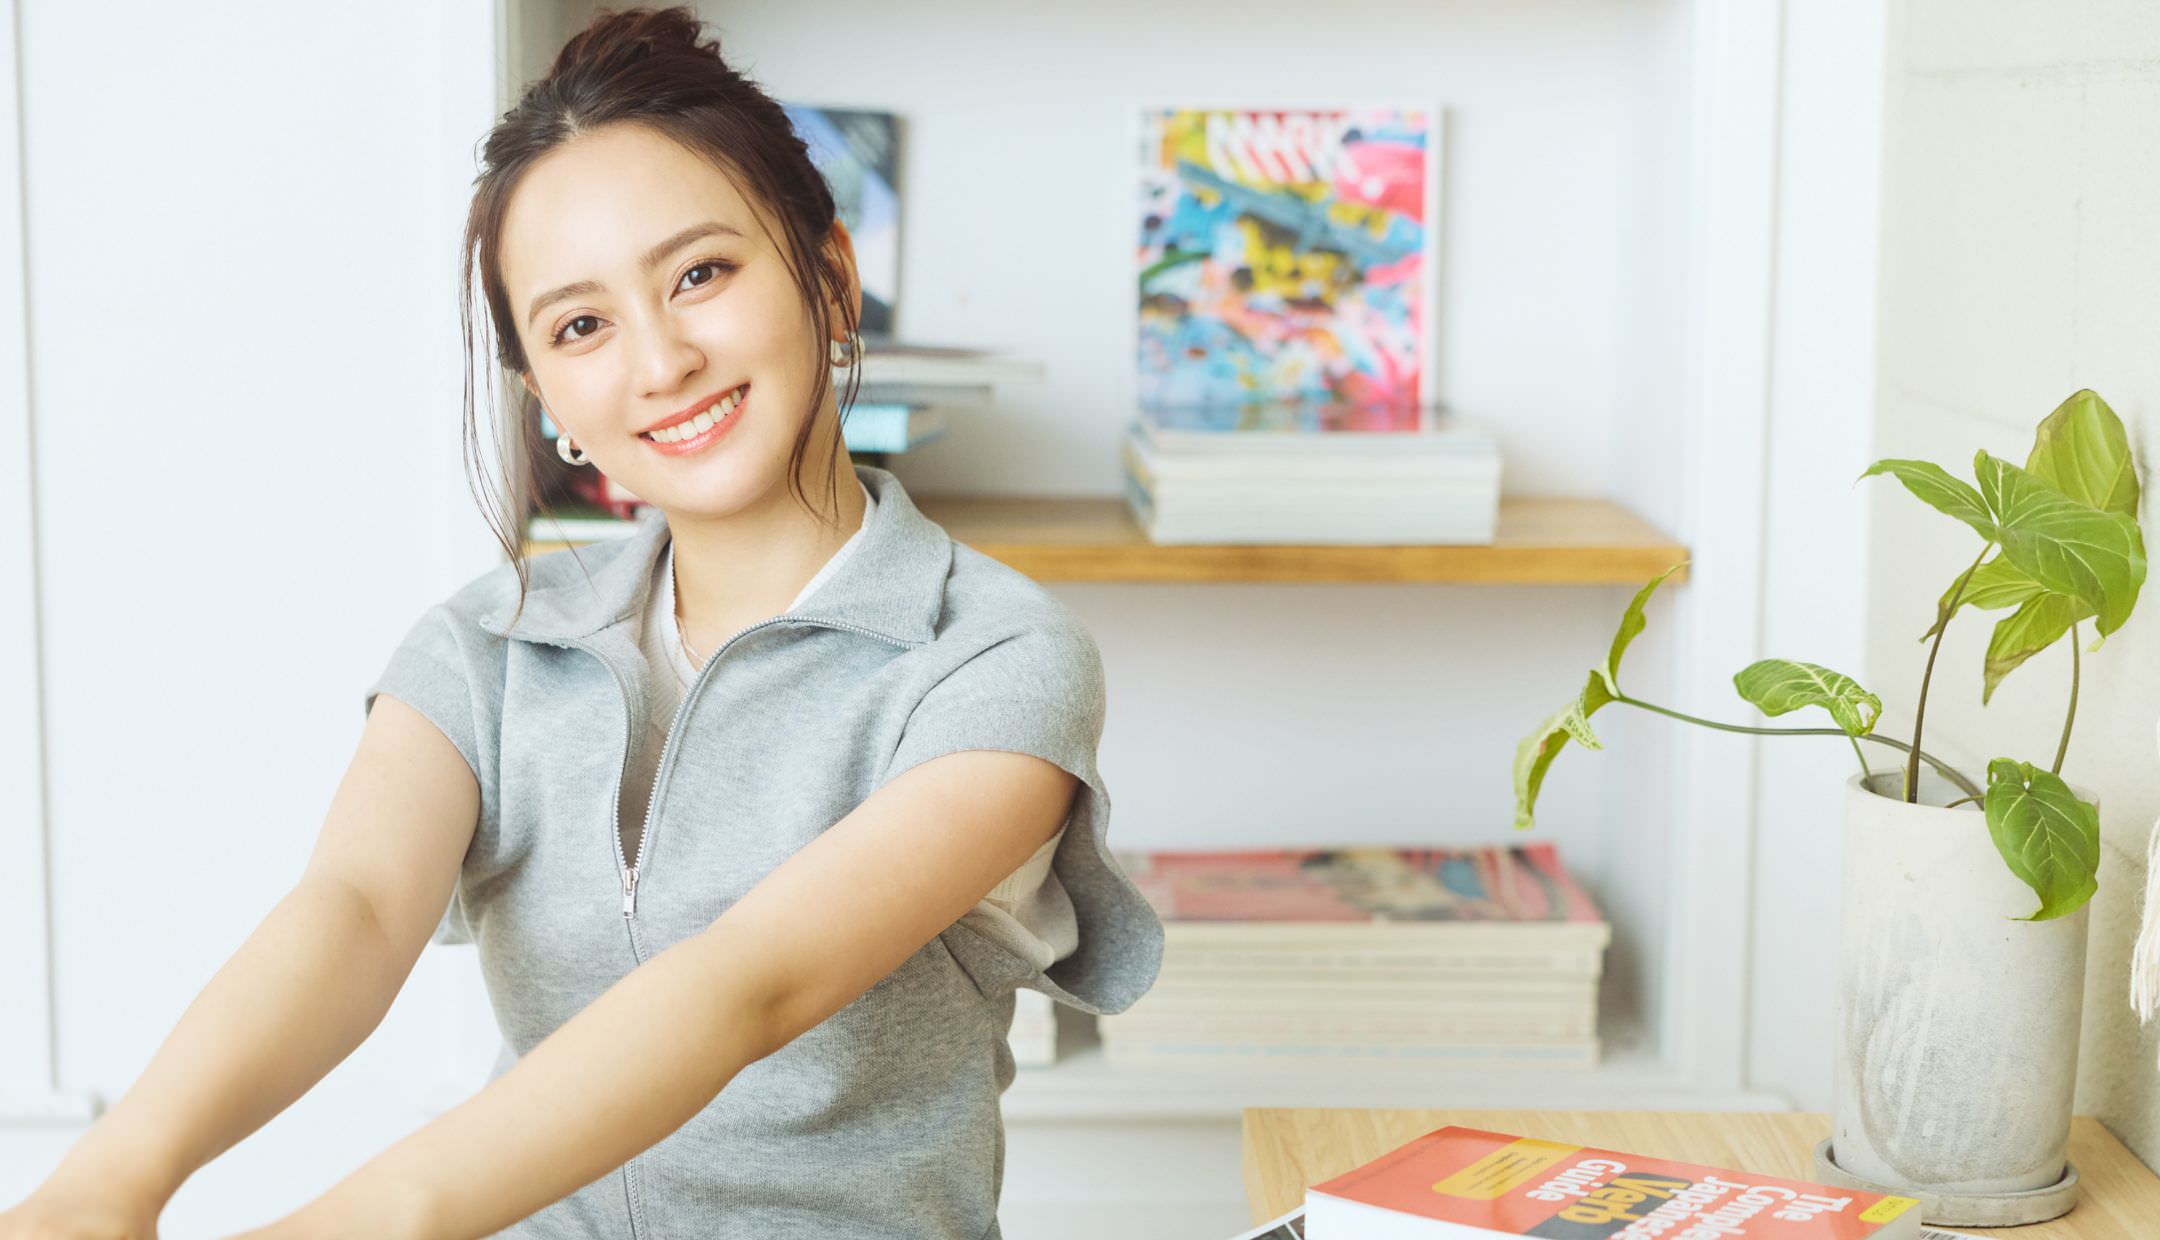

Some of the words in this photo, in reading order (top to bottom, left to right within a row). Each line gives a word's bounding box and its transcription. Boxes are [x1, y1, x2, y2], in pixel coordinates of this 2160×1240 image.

[1525, 1158, 1627, 1201] Guide
[1558, 1177, 1690, 1224] Verb
[1606, 1176, 1750, 1240] Japanese
[1669, 1186, 1798, 1240] Comple
[1772, 1193, 1854, 1221] The
